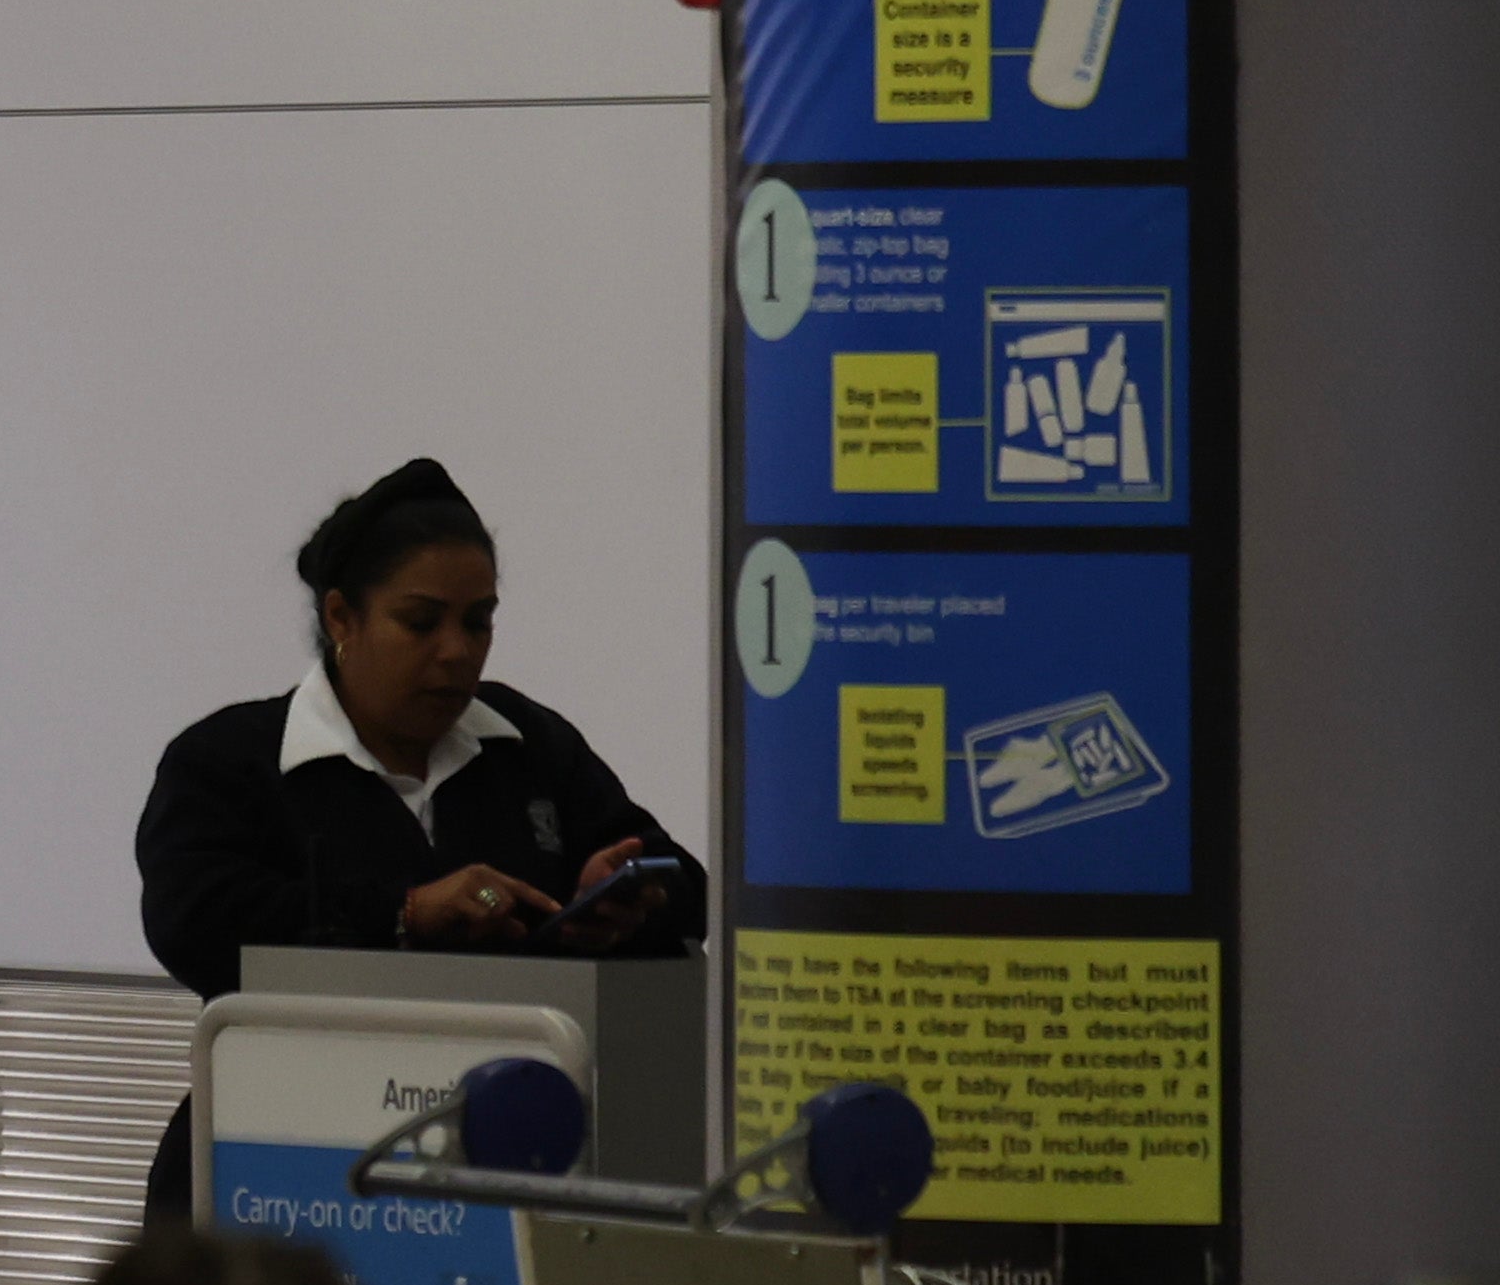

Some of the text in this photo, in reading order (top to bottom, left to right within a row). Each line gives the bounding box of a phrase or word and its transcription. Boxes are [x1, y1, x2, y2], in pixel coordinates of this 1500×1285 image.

[883, 0, 981, 21] Container
[893, 59, 970, 81] security
[890, 90, 974, 106] measure
[1007, 962, 1208, 982] items but must
[1072, 992, 1209, 1014] checkpoint
[1087, 1019, 1209, 1041] described
[947, 1049, 1053, 1068] container
[1061, 1050, 1162, 1070] exceeds
[1173, 1048, 1209, 1070] 3.4
[957, 1076, 1012, 1101] baby
[1026, 1076, 1147, 1101] food/juice
[1058, 1108, 1209, 1128] medications
[1041, 1134, 1129, 1156] include
[1139, 1135, 1209, 1162] juice)
[956, 1163, 1046, 1183] medical
[233, 1187, 467, 1238] Carry-on or check?
